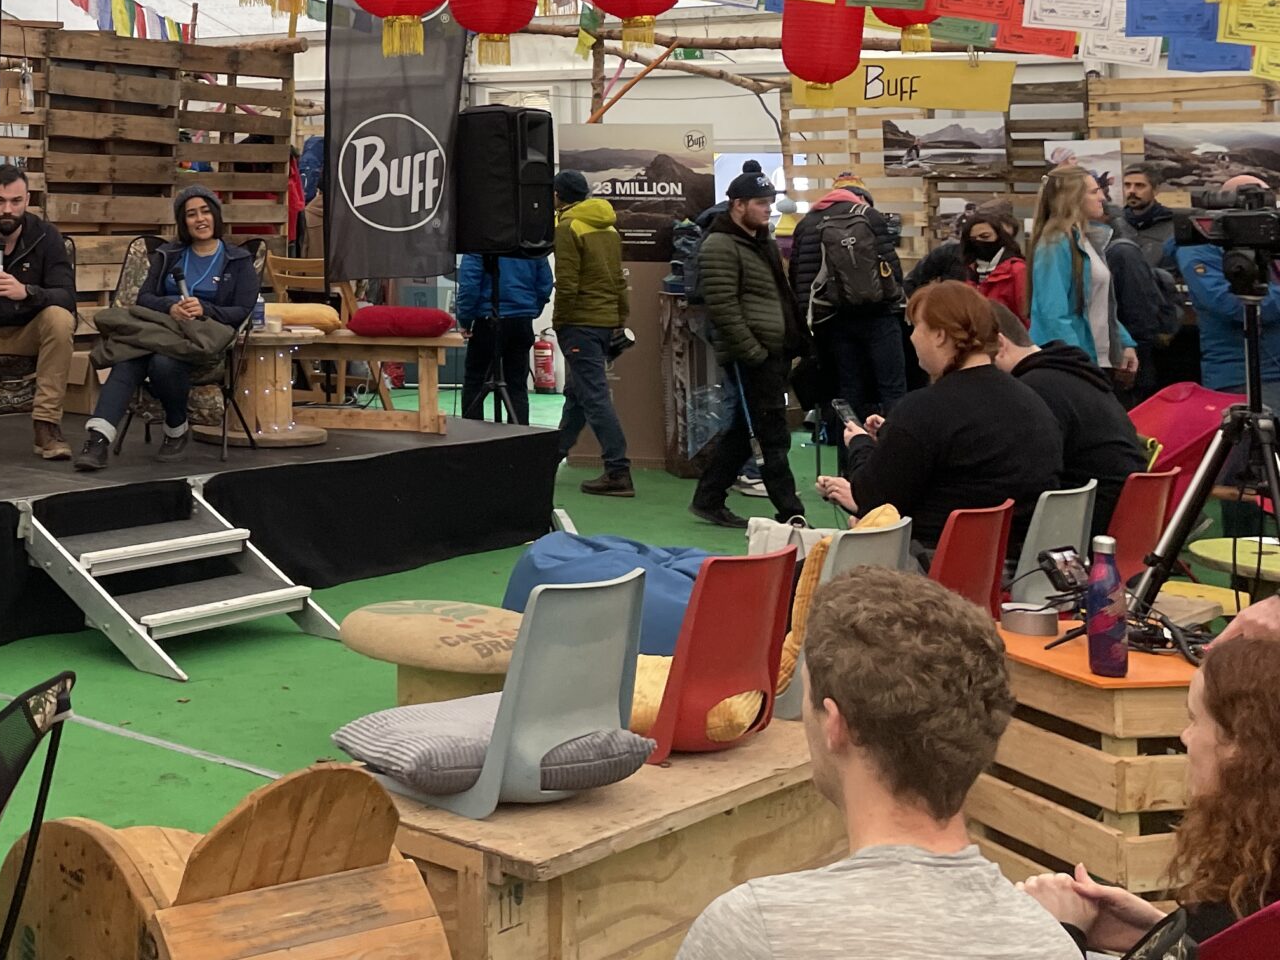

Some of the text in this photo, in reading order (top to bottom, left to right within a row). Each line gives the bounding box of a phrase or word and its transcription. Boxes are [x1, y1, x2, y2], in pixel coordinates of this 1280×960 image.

[687, 135, 705, 148] Buff
[350, 136, 440, 213] Buff
[592, 182, 682, 195] 23 MILLION
